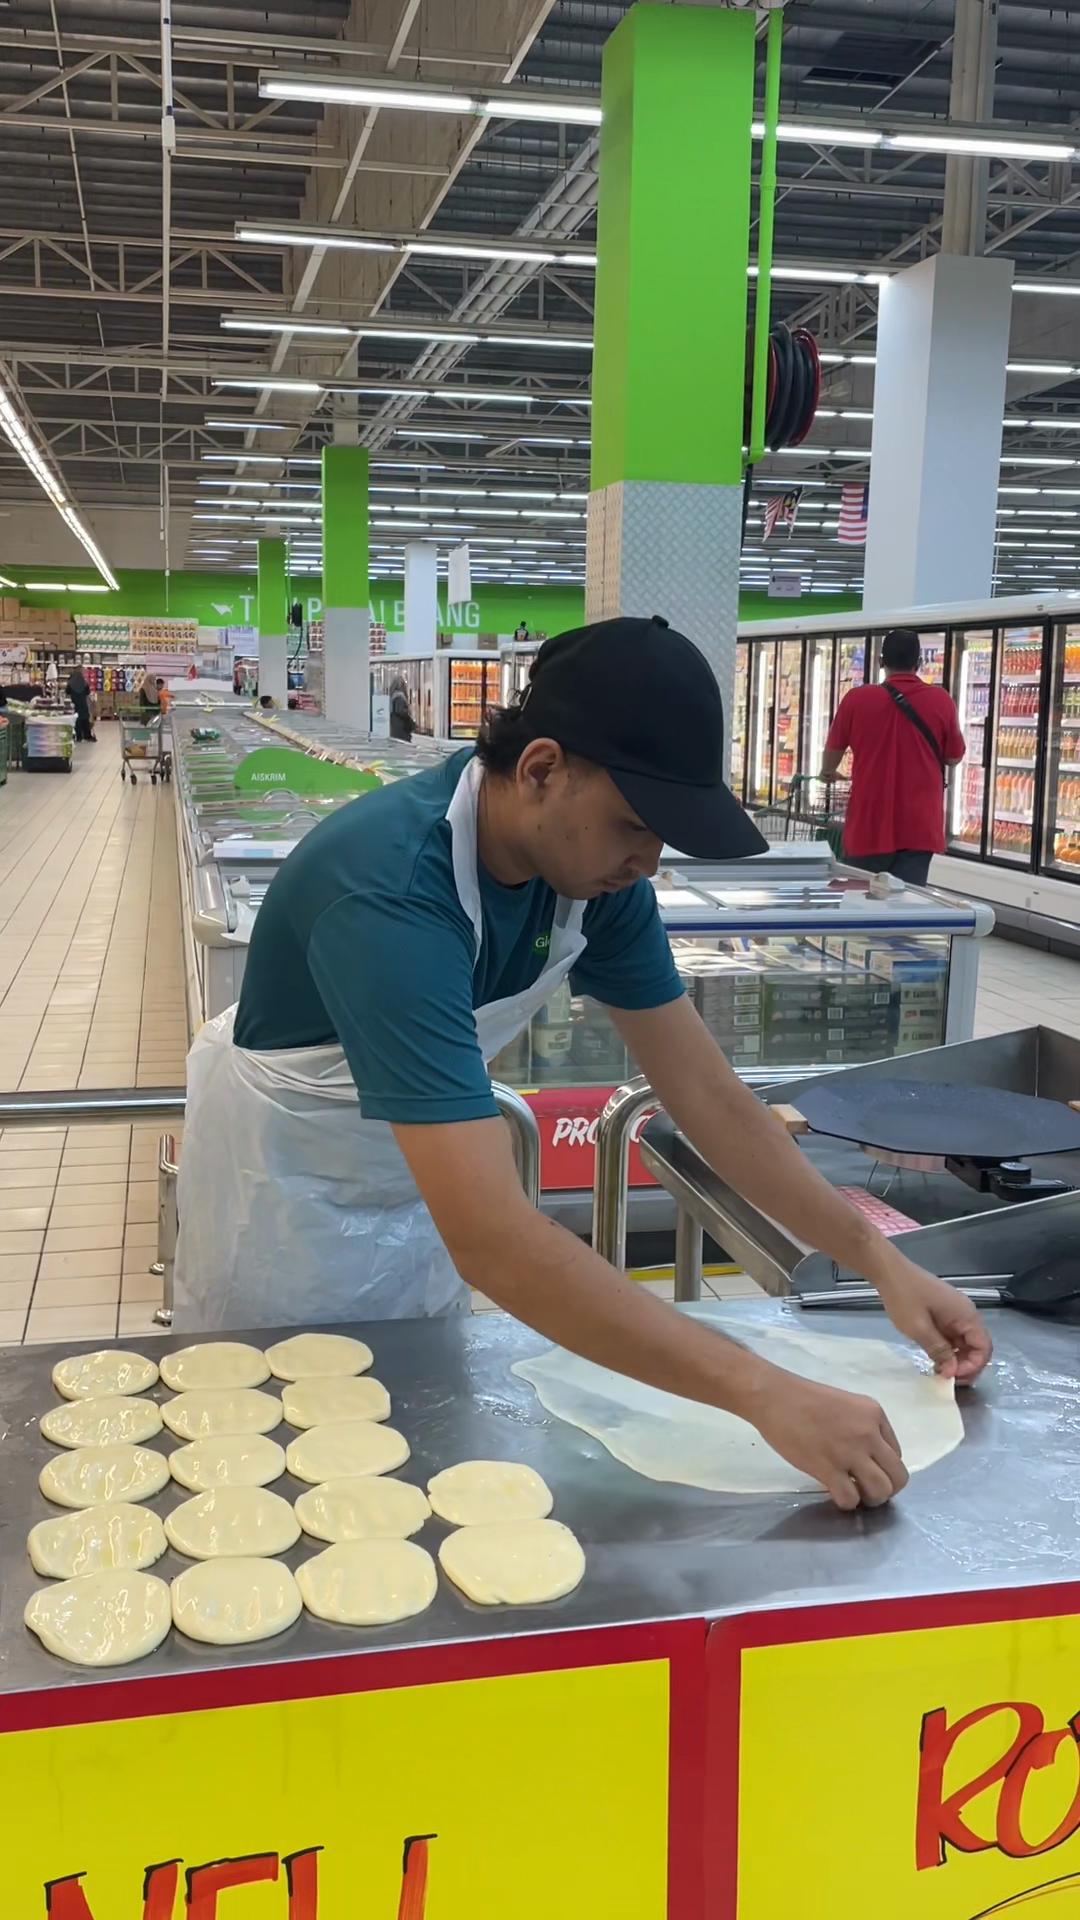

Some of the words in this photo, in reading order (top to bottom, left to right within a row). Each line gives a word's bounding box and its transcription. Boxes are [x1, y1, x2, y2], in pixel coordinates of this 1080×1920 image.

[394, 599, 479, 628] BANG
[251, 773, 286, 782] AISKRIM
[915, 1701, 1080, 1871] RO
